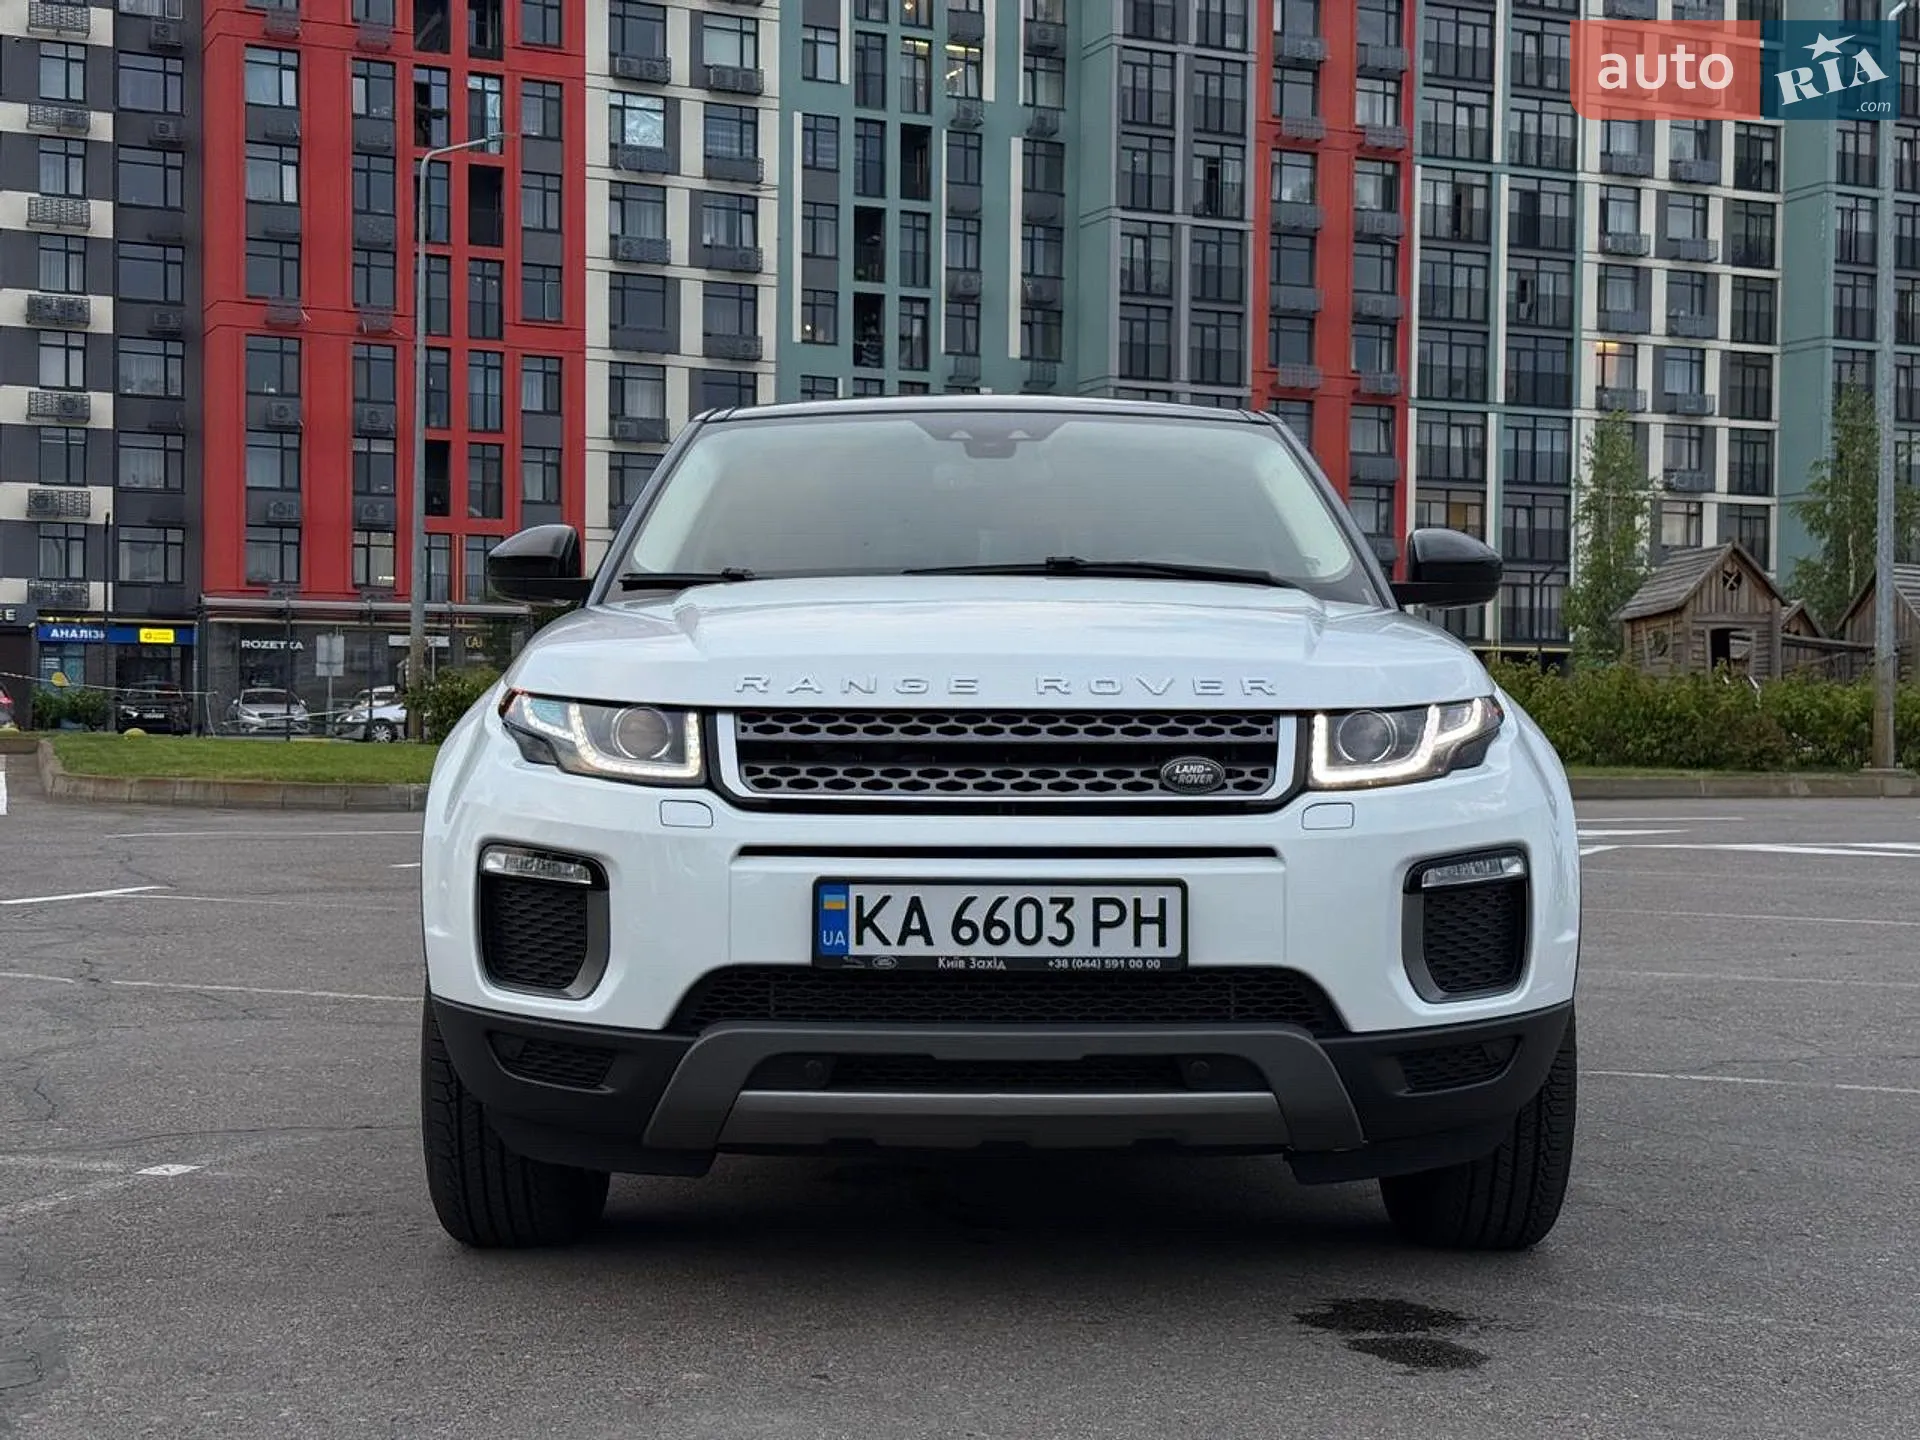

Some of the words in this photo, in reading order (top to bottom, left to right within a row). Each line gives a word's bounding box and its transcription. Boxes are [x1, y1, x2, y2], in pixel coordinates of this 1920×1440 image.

[0, 608, 16, 621] E
[735, 674, 980, 694] RANGE
[1034, 674, 1278, 696] ROVER
[1175, 764, 1204, 774] LAND
[1177, 773, 1214, 785] ROVER
[854, 895, 935, 947] KA
[950, 895, 1076, 947] 6603
[1091, 896, 1167, 948] PH
[822, 931, 846, 947] UA
[1048, 958, 1068, 970] +38
[1071, 958, 1101, 971] (044)
[1128, 958, 1143, 970] 00
[1146, 958, 1161, 970] 00
